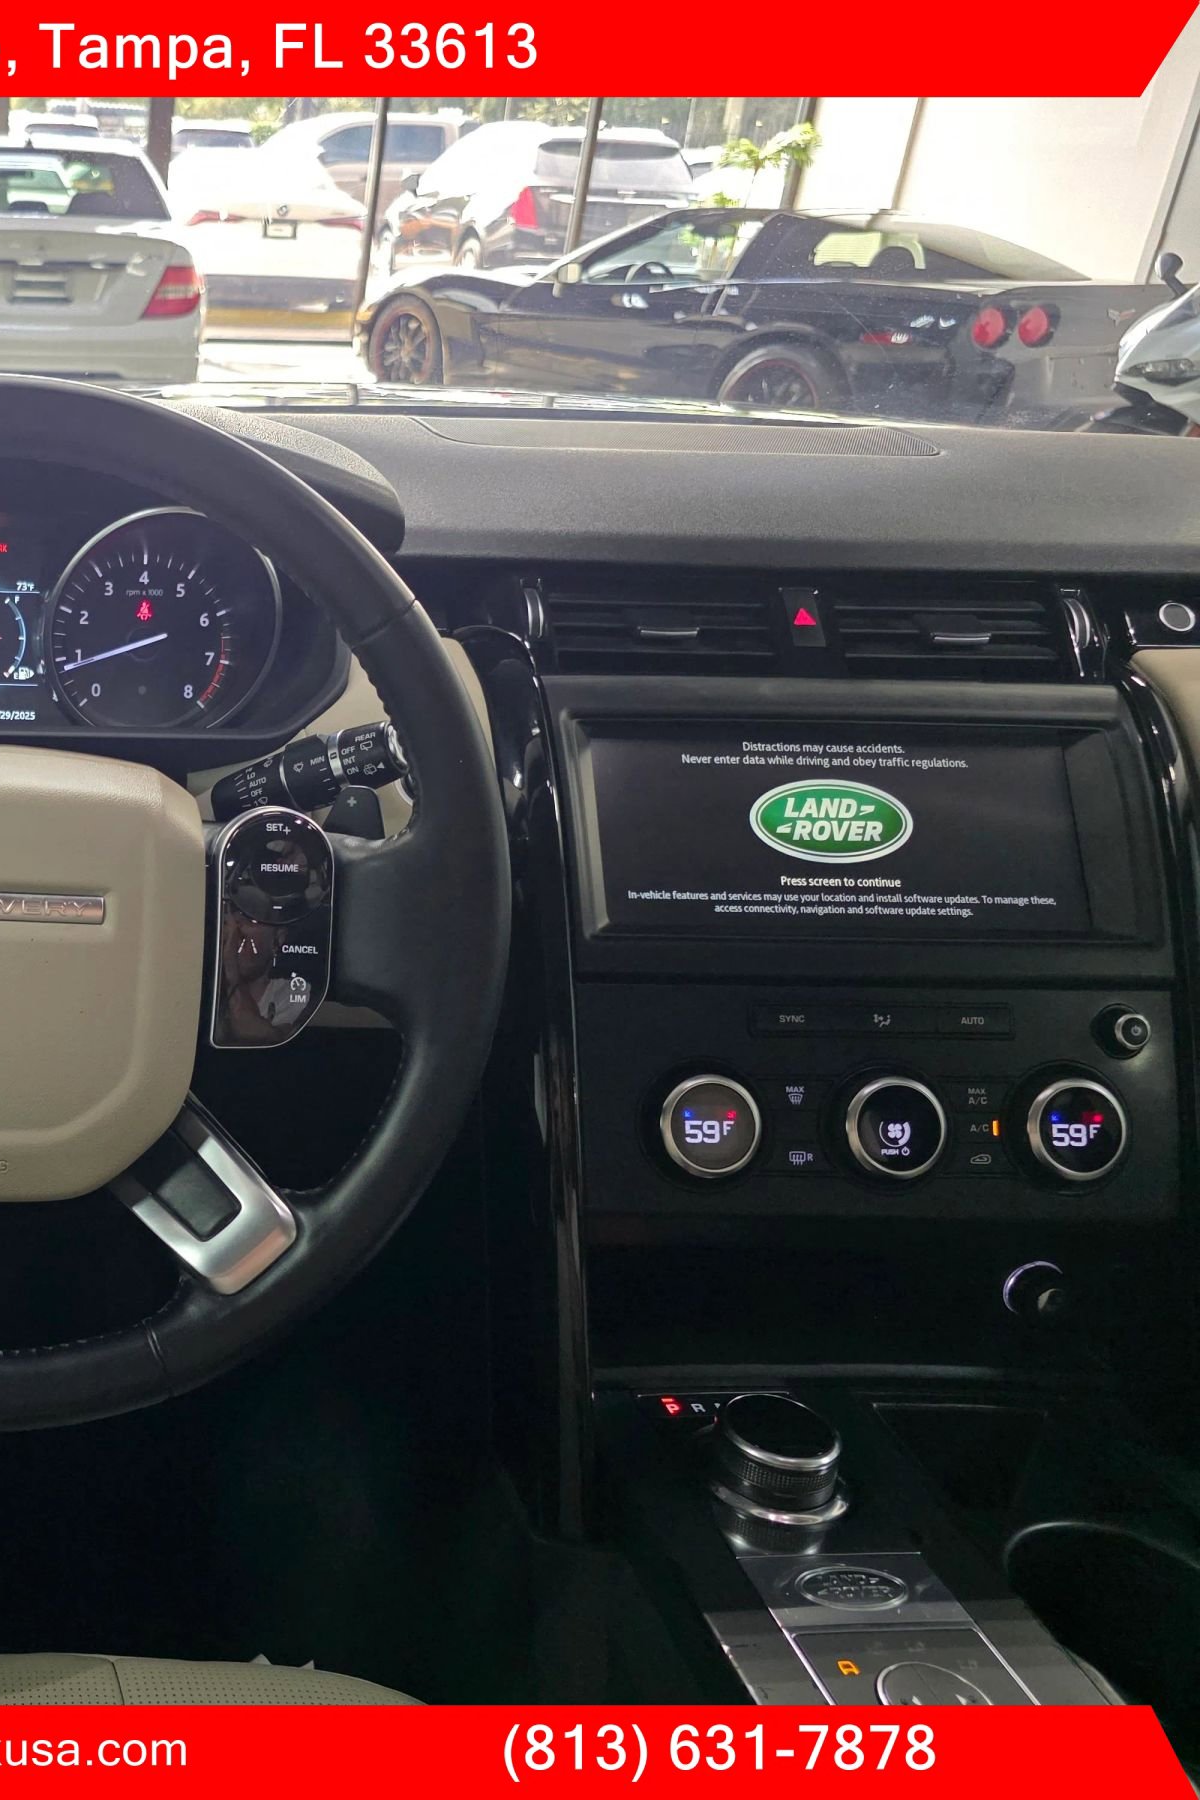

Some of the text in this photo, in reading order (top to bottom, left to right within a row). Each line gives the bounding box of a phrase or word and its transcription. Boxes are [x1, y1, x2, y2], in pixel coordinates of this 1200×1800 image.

[139, 571, 149, 585] 4
[104, 582, 114, 596] 3
[176, 584, 185, 598] 5
[79, 611, 89, 625] 2
[200, 613, 210, 627] 6
[75, 649, 82, 663] 1
[204, 652, 215, 666] 7
[91, 683, 101, 697] 0
[183, 685, 193, 699] 8
[355, 732, 376, 743] REAR
[341, 746, 356, 755] OFF
[742, 742, 905, 755] Distractions may cause accidents.
[310, 756, 325, 766] MIN
[343, 756, 356, 766] INT
[682, 754, 969, 770] Never enter data while driving and obey traffic regulations.
[246, 772, 256, 780] LO
[347, 766, 359, 775] ON
[249, 777, 267, 788] AUTO
[251, 788, 263, 797] OFF
[784, 797, 858, 819] LAND
[792, 820, 883, 842] ROVER
[260, 863, 299, 873] RESUME
[780, 876, 902, 888] Press screen to continue
[628, 890, 1057, 907] In-vehicle features and services may use your location and install software updates. To manage these,
[714, 904, 974, 918] access connectivity, navigation and software update settings.
[281, 945, 319, 955] CANCEL
[289, 994, 306, 1003] LIM
[779, 1014, 805, 1024] SYNC
[961, 1016, 985, 1025] AUTO
[968, 1097, 988, 1105] A/C
[970, 1124, 989, 1132] A/C
[807, 1153, 814, 1161] R
[881, 1148, 899, 1156] PUSH
[665, 1403, 680, 1414] P
[690, 1403, 706, 1413] R
